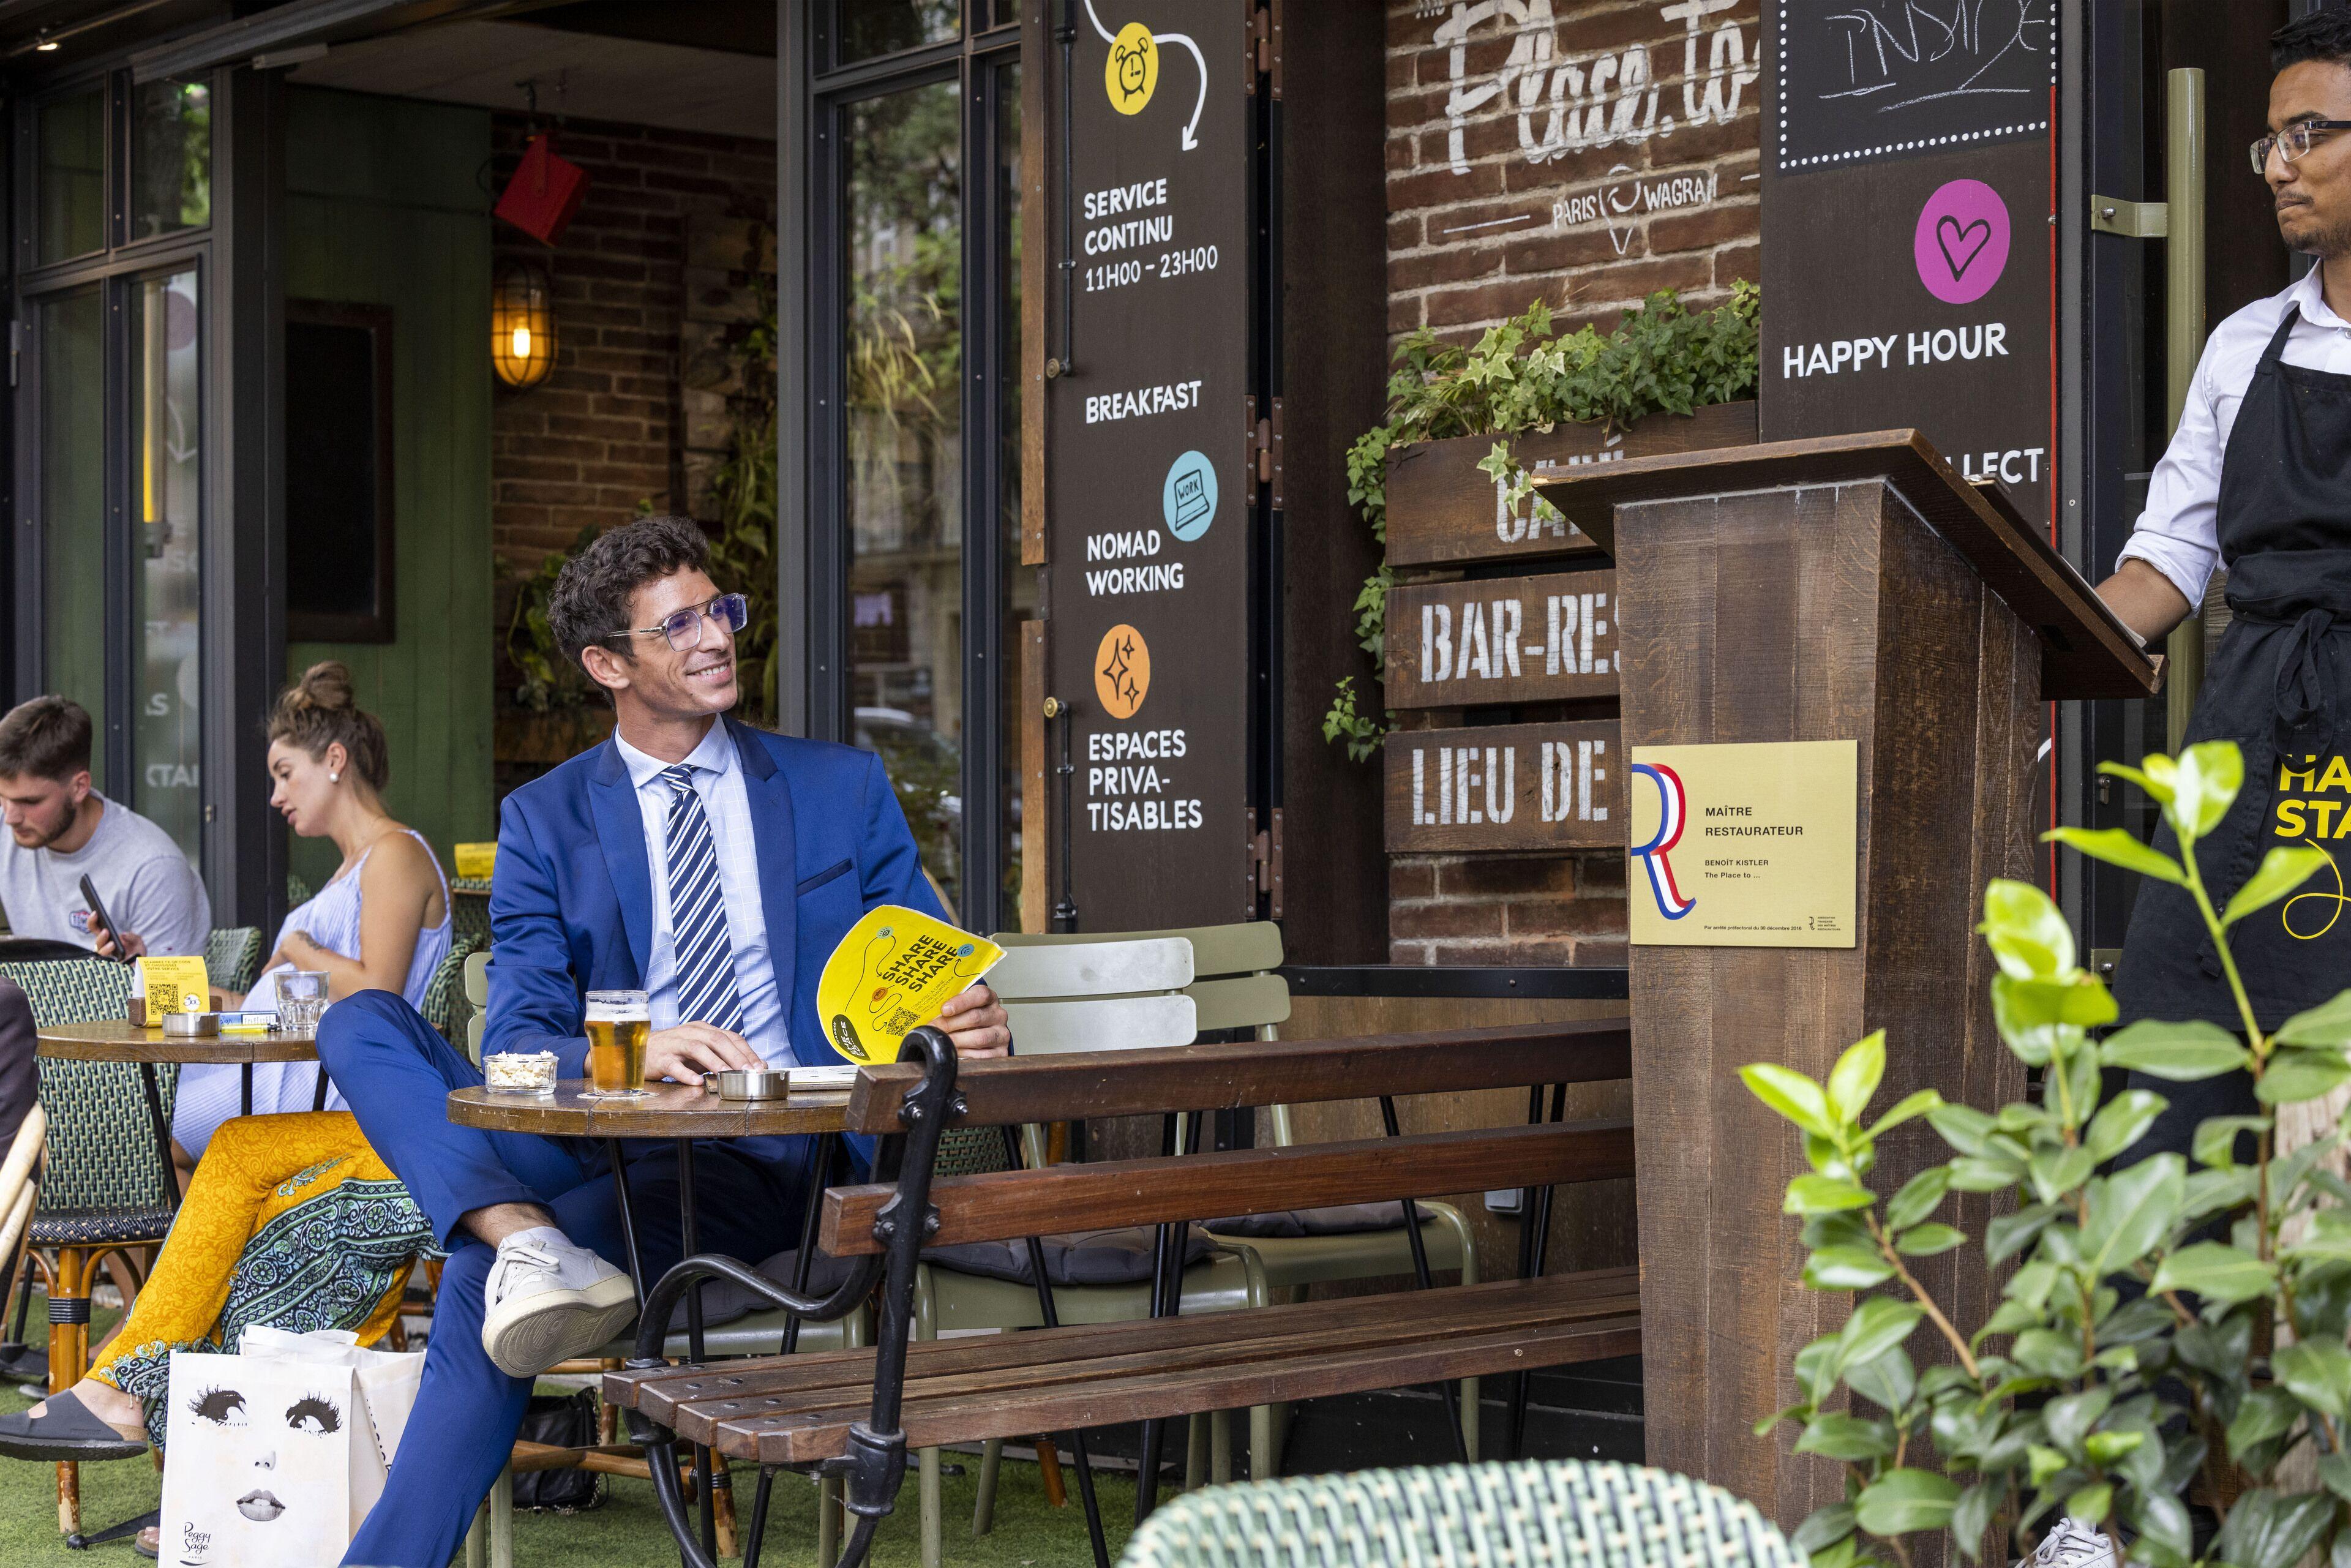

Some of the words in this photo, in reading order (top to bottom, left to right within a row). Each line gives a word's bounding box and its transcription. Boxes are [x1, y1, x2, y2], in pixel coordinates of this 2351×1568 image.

[1084, 178, 1167, 220] SERVICE
[1553, 195, 1596, 230] PARIS
[1084, 215, 1173, 255] CONTINU
[1086, 260, 1141, 292] 11H00
[1160, 245, 1218, 279] 23H00
[1783, 334, 1898, 379] HAPPY
[1908, 323, 2009, 366] HOUR
[1086, 380, 1202, 424] BREAKFAST
[1177, 478, 1199, 500] WORK
[1087, 530, 1161, 562] NOMAD
[1086, 563, 1184, 596] WORKING
[1421, 593, 1619, 683] BAR-RE
[1089, 729, 1187, 761] ESPACES
[1089, 765, 1170, 796] PRIVA-
[1412, 747, 1515, 825] LIEU
[1542, 740, 1608, 822] DE
[1087, 799, 1203, 831] TISABLES
[1706, 805, 1752, 816] MAÎTRE
[1706, 827, 1803, 836] RESTAURATEUR
[882, 934, 934, 981] SHARE
[895, 940, 947, 986] SHARE
[909, 947, 958, 992] SHARE
[182, 1539, 209, 1555] Sage
[184, 1521, 211, 1544] Peggy
